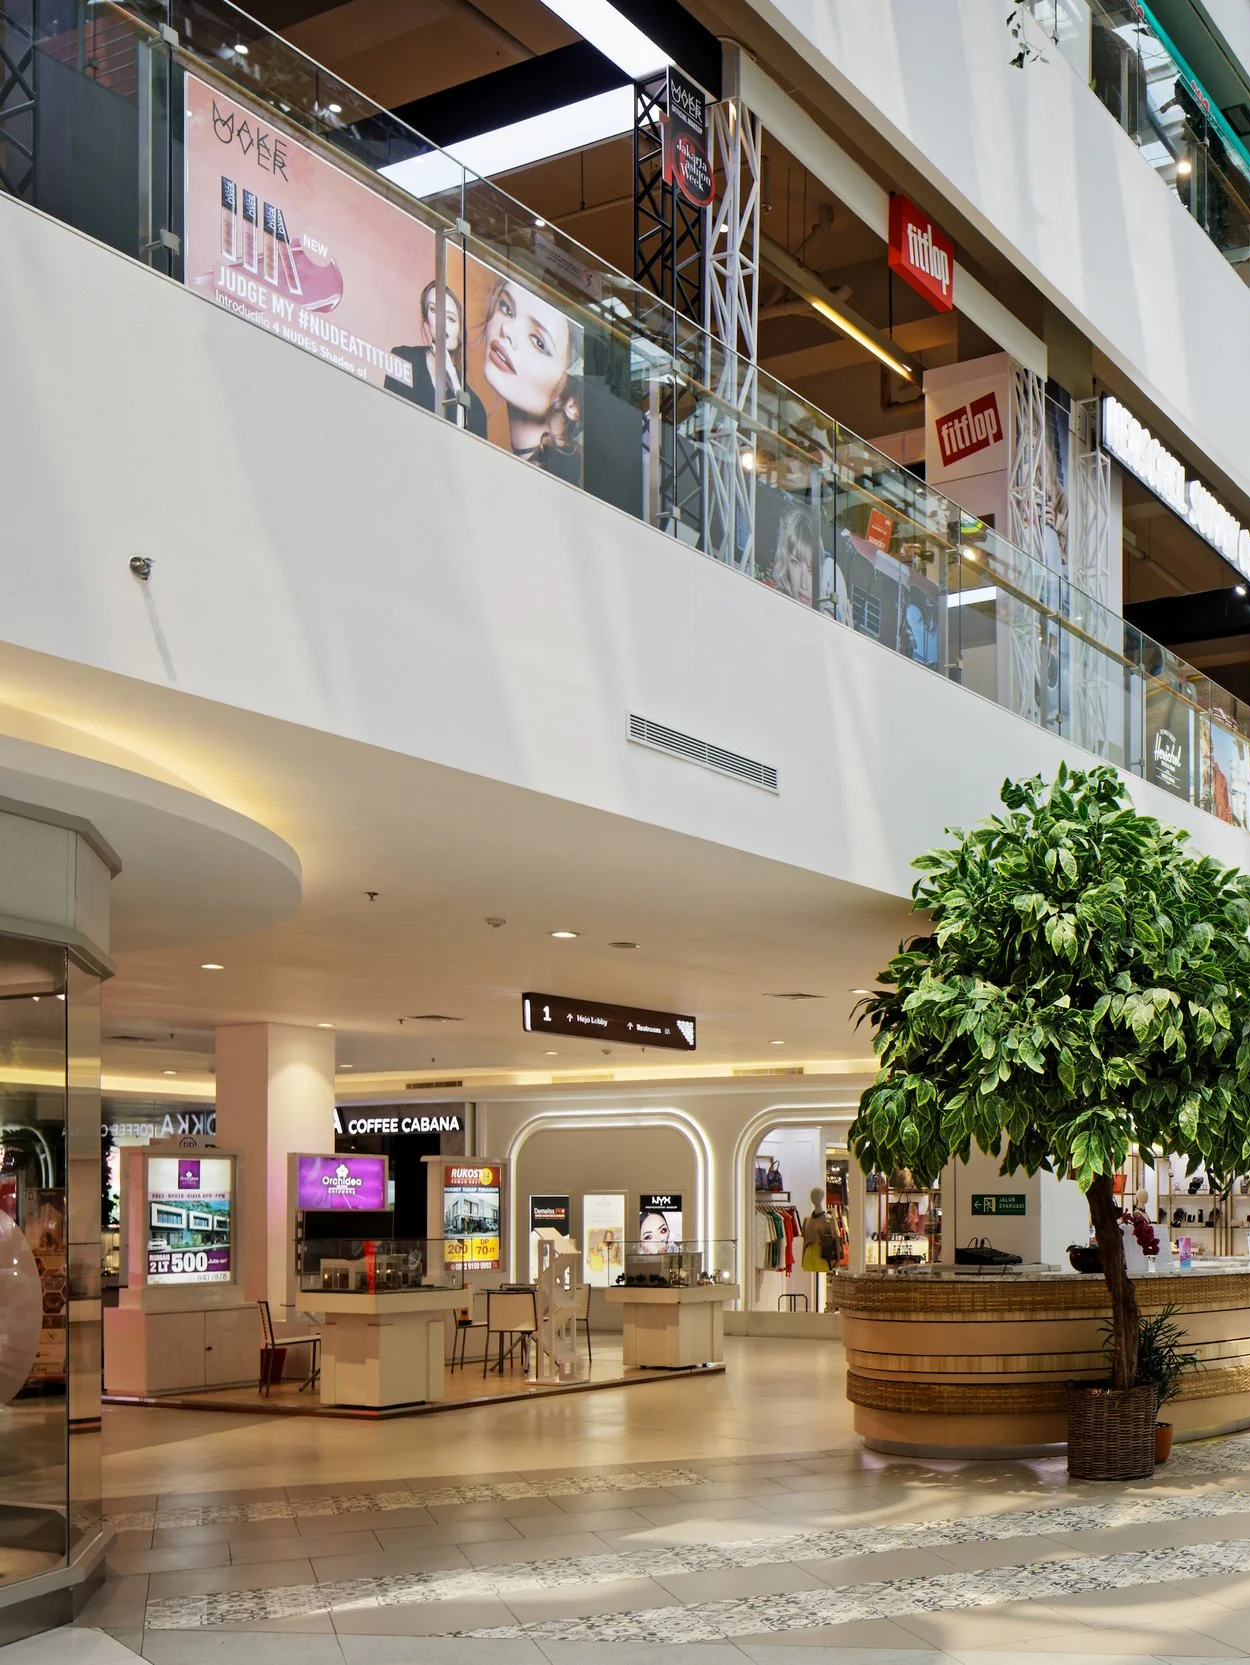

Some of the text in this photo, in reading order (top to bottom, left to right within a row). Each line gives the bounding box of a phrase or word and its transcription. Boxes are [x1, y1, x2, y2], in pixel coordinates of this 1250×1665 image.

[213, 100, 288, 157] MAKE
[213, 118, 288, 182] OVER
[676, 138, 707, 172] Jakarta
[680, 162, 705, 192] Week
[303, 233, 328, 258] NEW
[907, 223, 950, 296] fitflop
[217, 266, 411, 384] JUDGE MY #NUDEATTITUDE
[272, 322, 280, 333] 4
[283, 325, 318, 354] NUDES
[320, 346, 355, 372] Shades
[357, 367, 368, 379] of
[941, 404, 998, 457] fitflop
[542, 1005, 552, 1022] 1
[591, 1016, 608, 1027] Lobby
[348, 1118, 399, 1135] COFFEE
[401, 1115, 460, 1132] CABANA
[322, 1174, 362, 1186] Orchidea
[451, 1168, 483, 1178] RUKOST
[651, 1196, 671, 1206] NYX
[447, 1243, 468, 1255] 200
[476, 1245, 488, 1255] 70
[149, 1261, 170, 1273] 2 LT
[171, 1251, 208, 1273] 500
